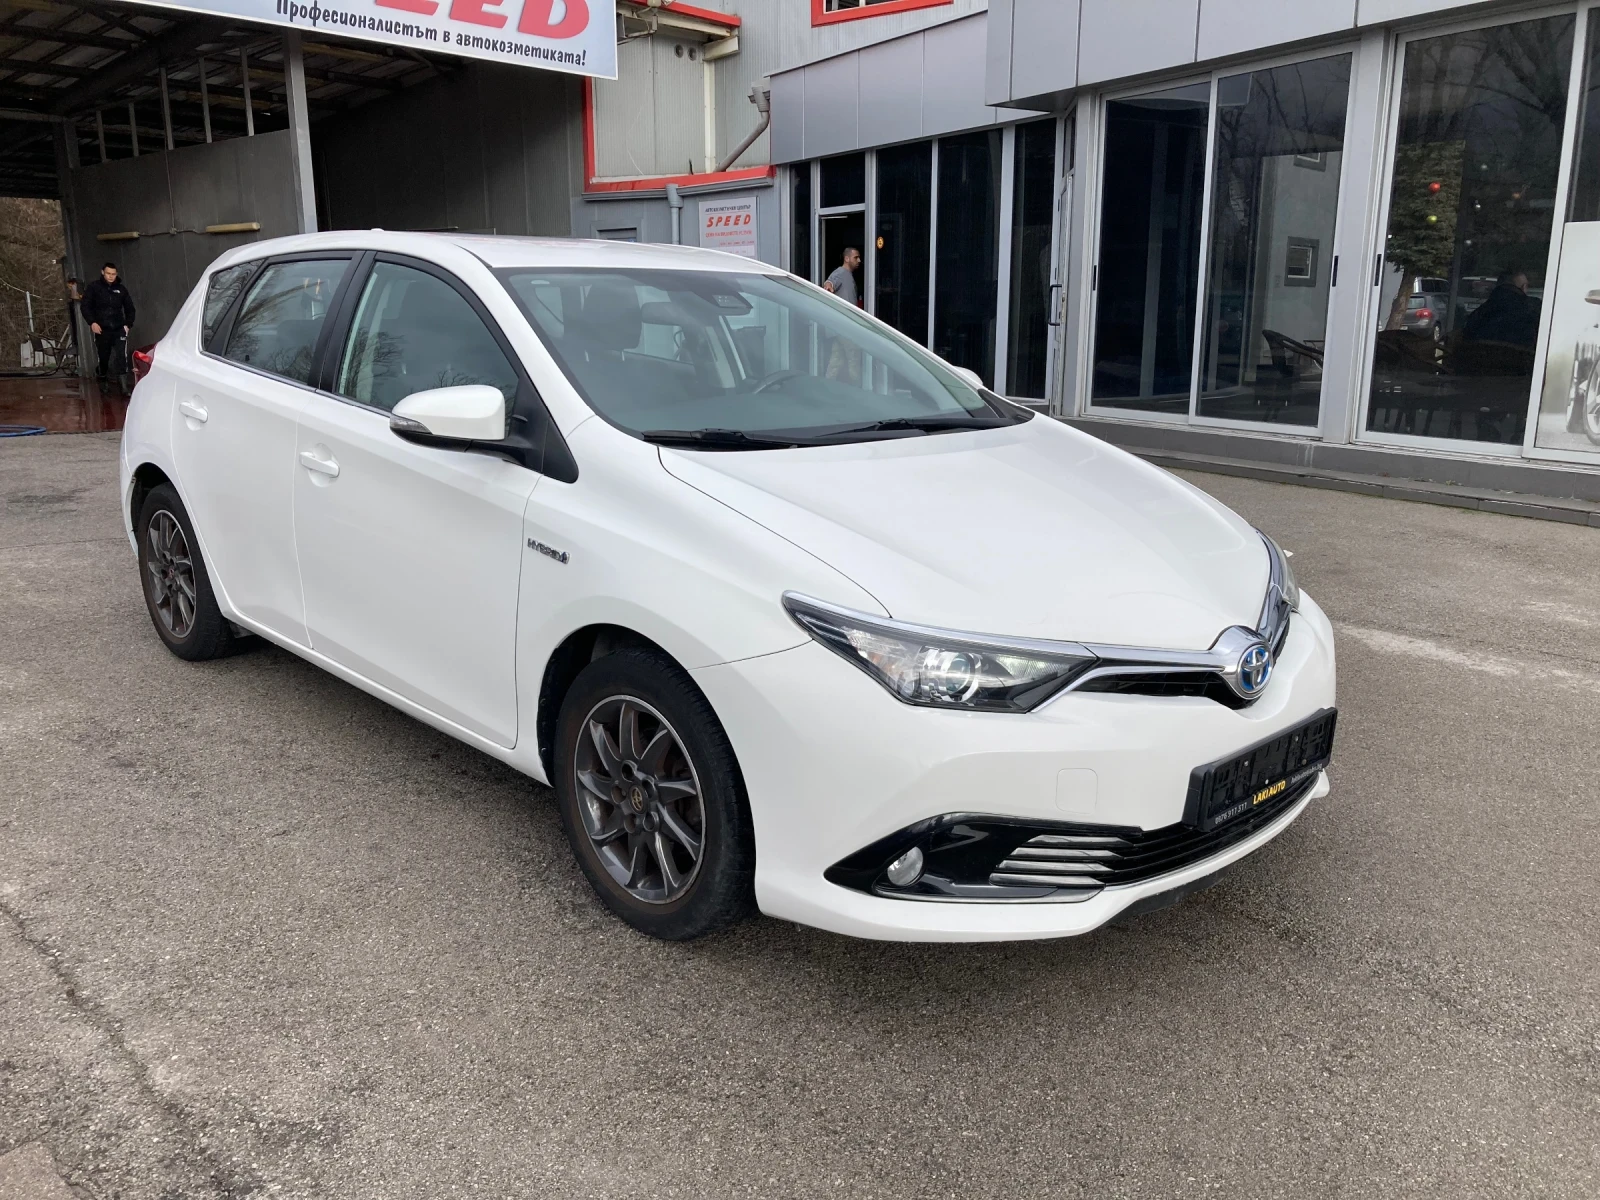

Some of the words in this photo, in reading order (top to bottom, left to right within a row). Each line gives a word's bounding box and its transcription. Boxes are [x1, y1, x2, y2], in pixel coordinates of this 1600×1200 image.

[277, 0, 438, 41] Професионалистът
[443, 30, 451, 43] в
[456, 32, 587, 66] автокозметиката!
[374, 0, 590, 39] ED
[706, 214, 751, 228] SPEED
